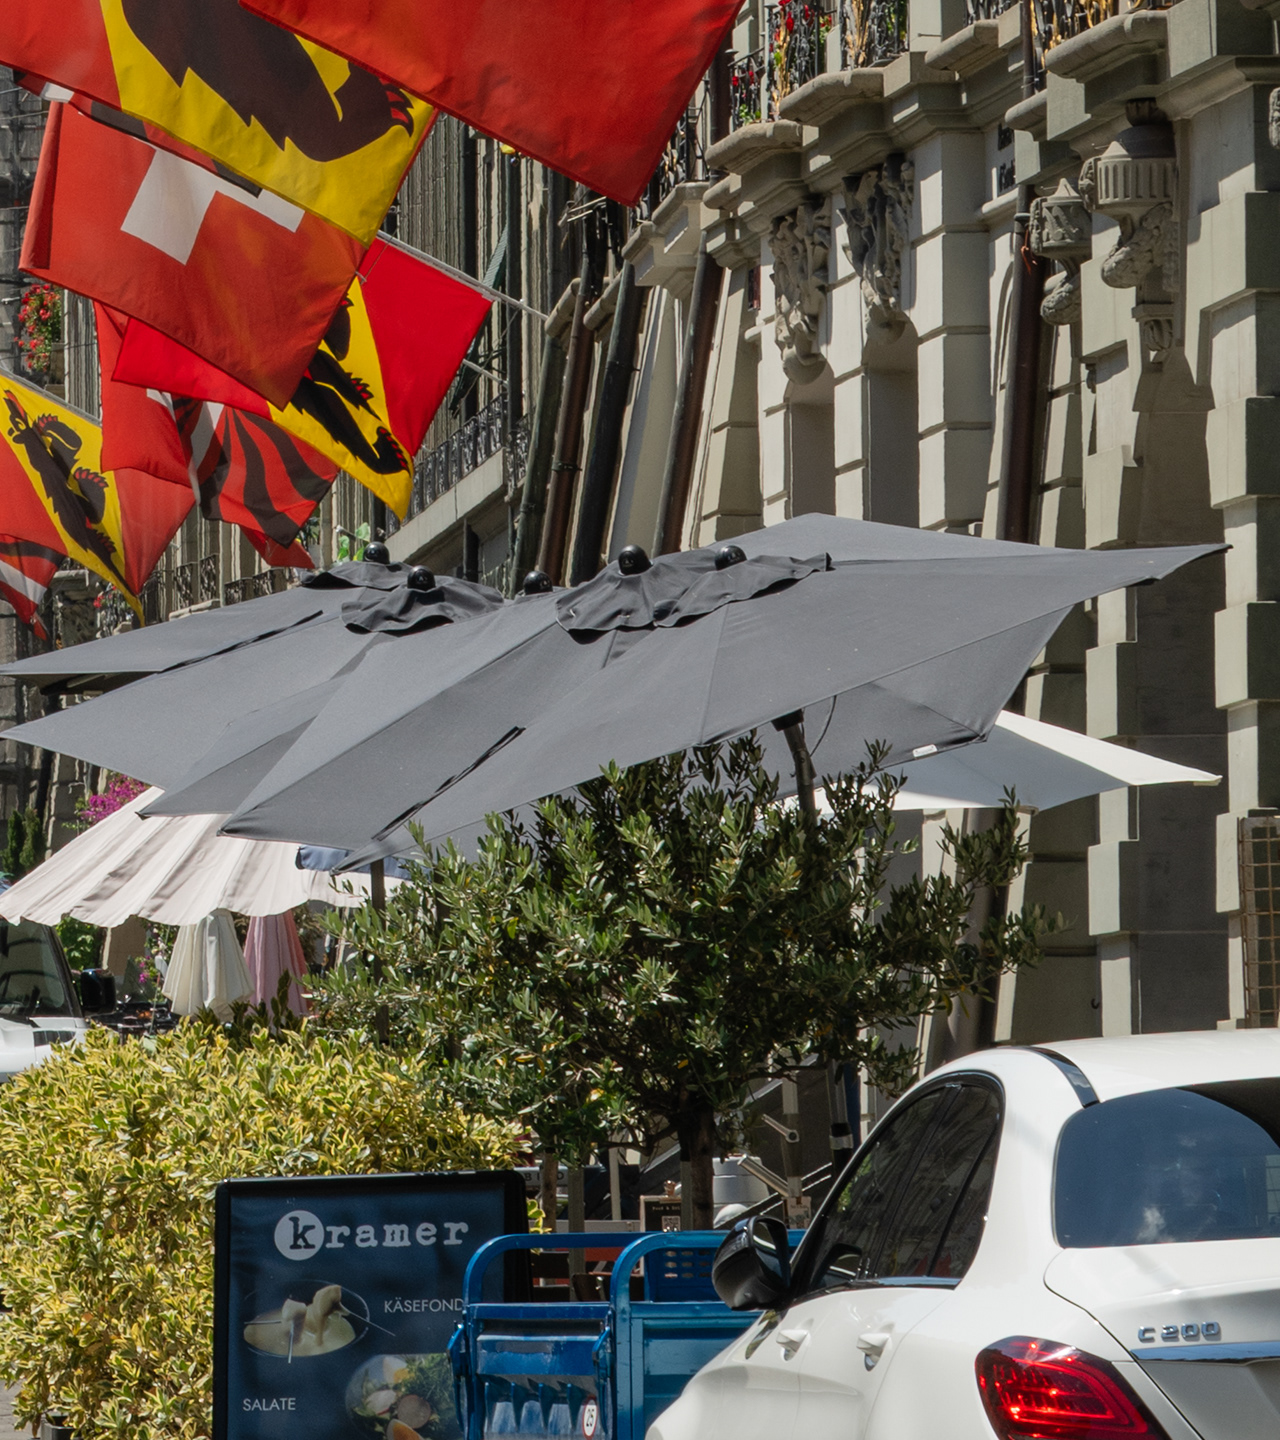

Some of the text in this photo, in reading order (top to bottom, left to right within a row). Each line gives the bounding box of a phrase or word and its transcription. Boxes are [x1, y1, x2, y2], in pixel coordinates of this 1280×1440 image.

[288, 1216, 469, 1250] kramer
[384, 1297, 464, 1313] KÄSEFOND
[1137, 1321, 1221, 1343] C 200
[242, 1397, 296, 1411] SALATE
